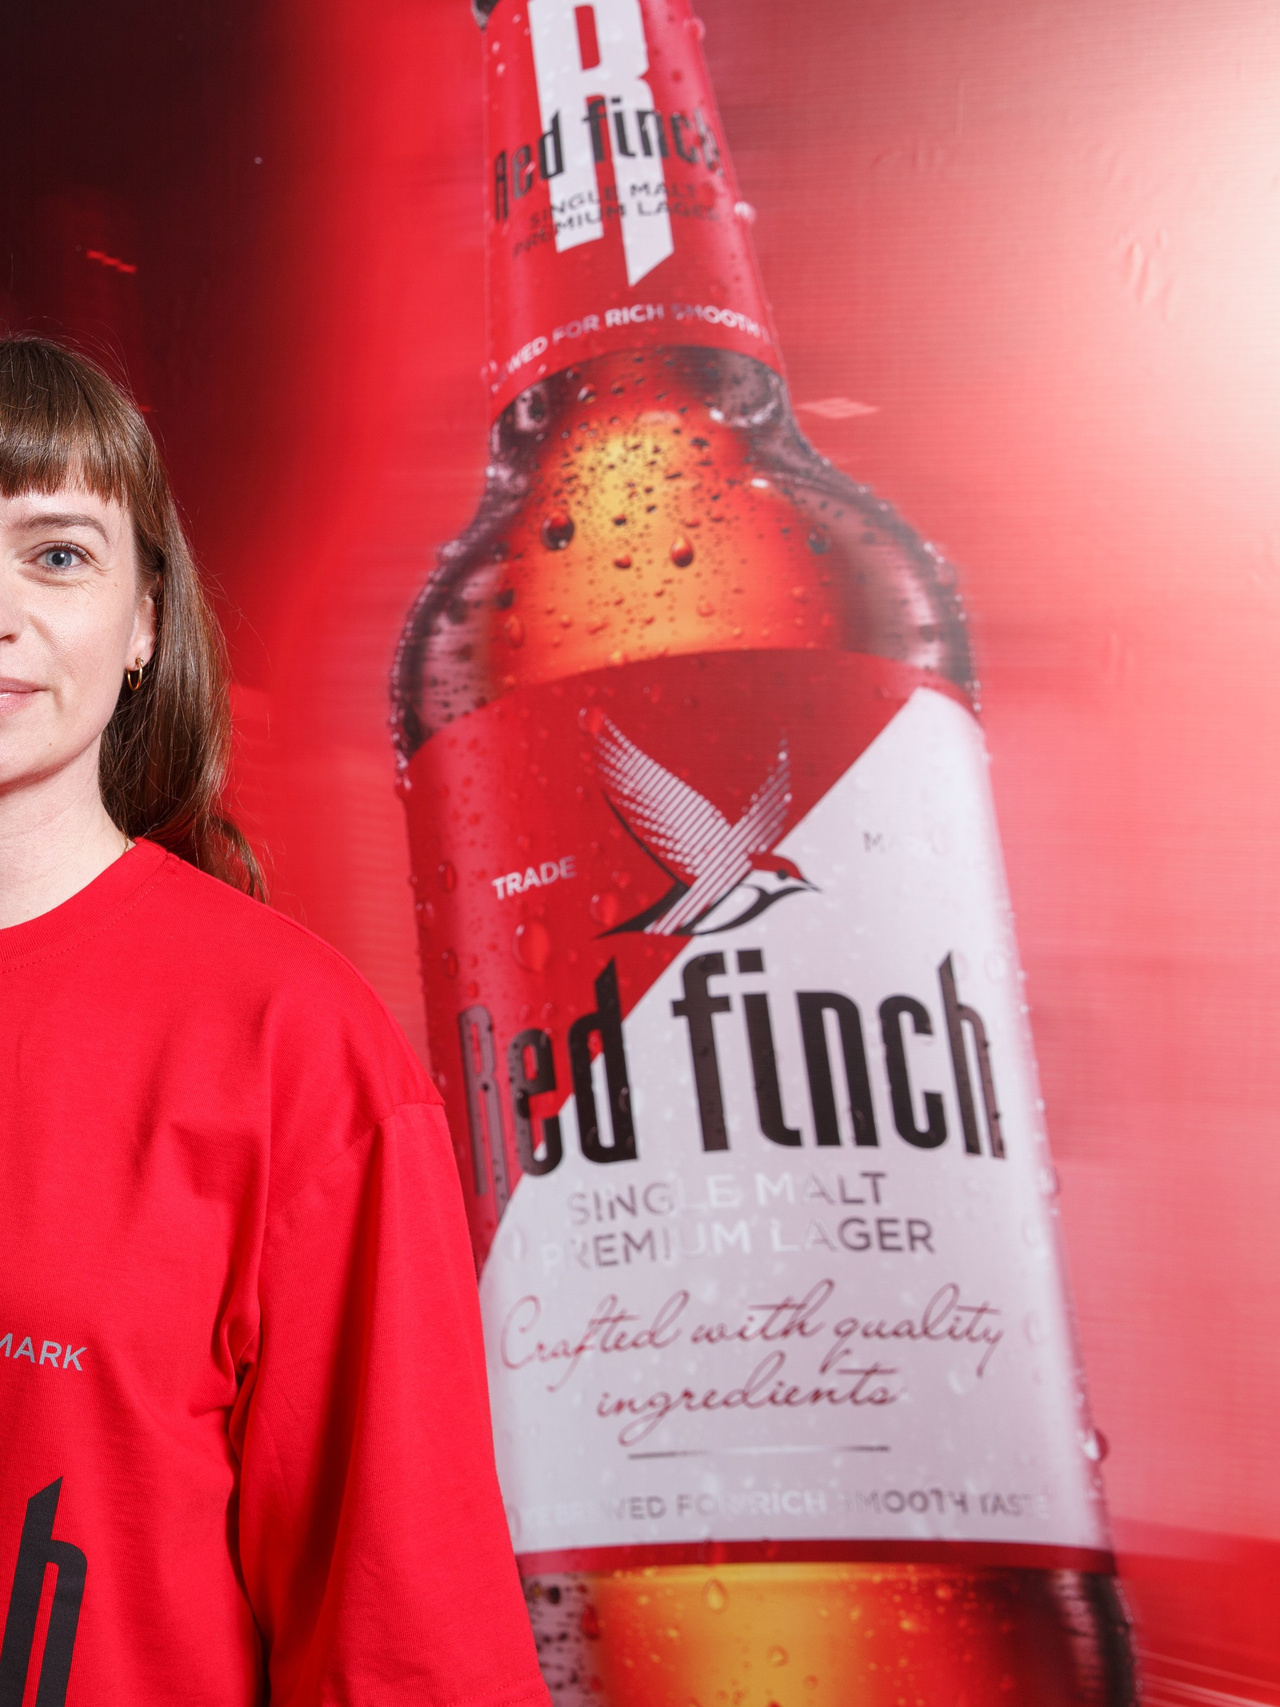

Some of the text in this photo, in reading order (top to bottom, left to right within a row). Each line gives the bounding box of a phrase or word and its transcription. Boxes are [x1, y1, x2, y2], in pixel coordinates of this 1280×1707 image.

[529, 181, 697, 230] SINGLE MALT
[552, 314, 600, 344] FOR
[605, 303, 665, 329] RICH
[491, 854, 578, 900] TRADE
[458, 947, 1006, 1223] Red finch
[567, 1170, 887, 1226] SINGLE MALT
[770, 1216, 937, 1254] LAGER
[500, 1278, 1006, 1392] Crafted with quality
[597, 1350, 903, 1447] ingredients
